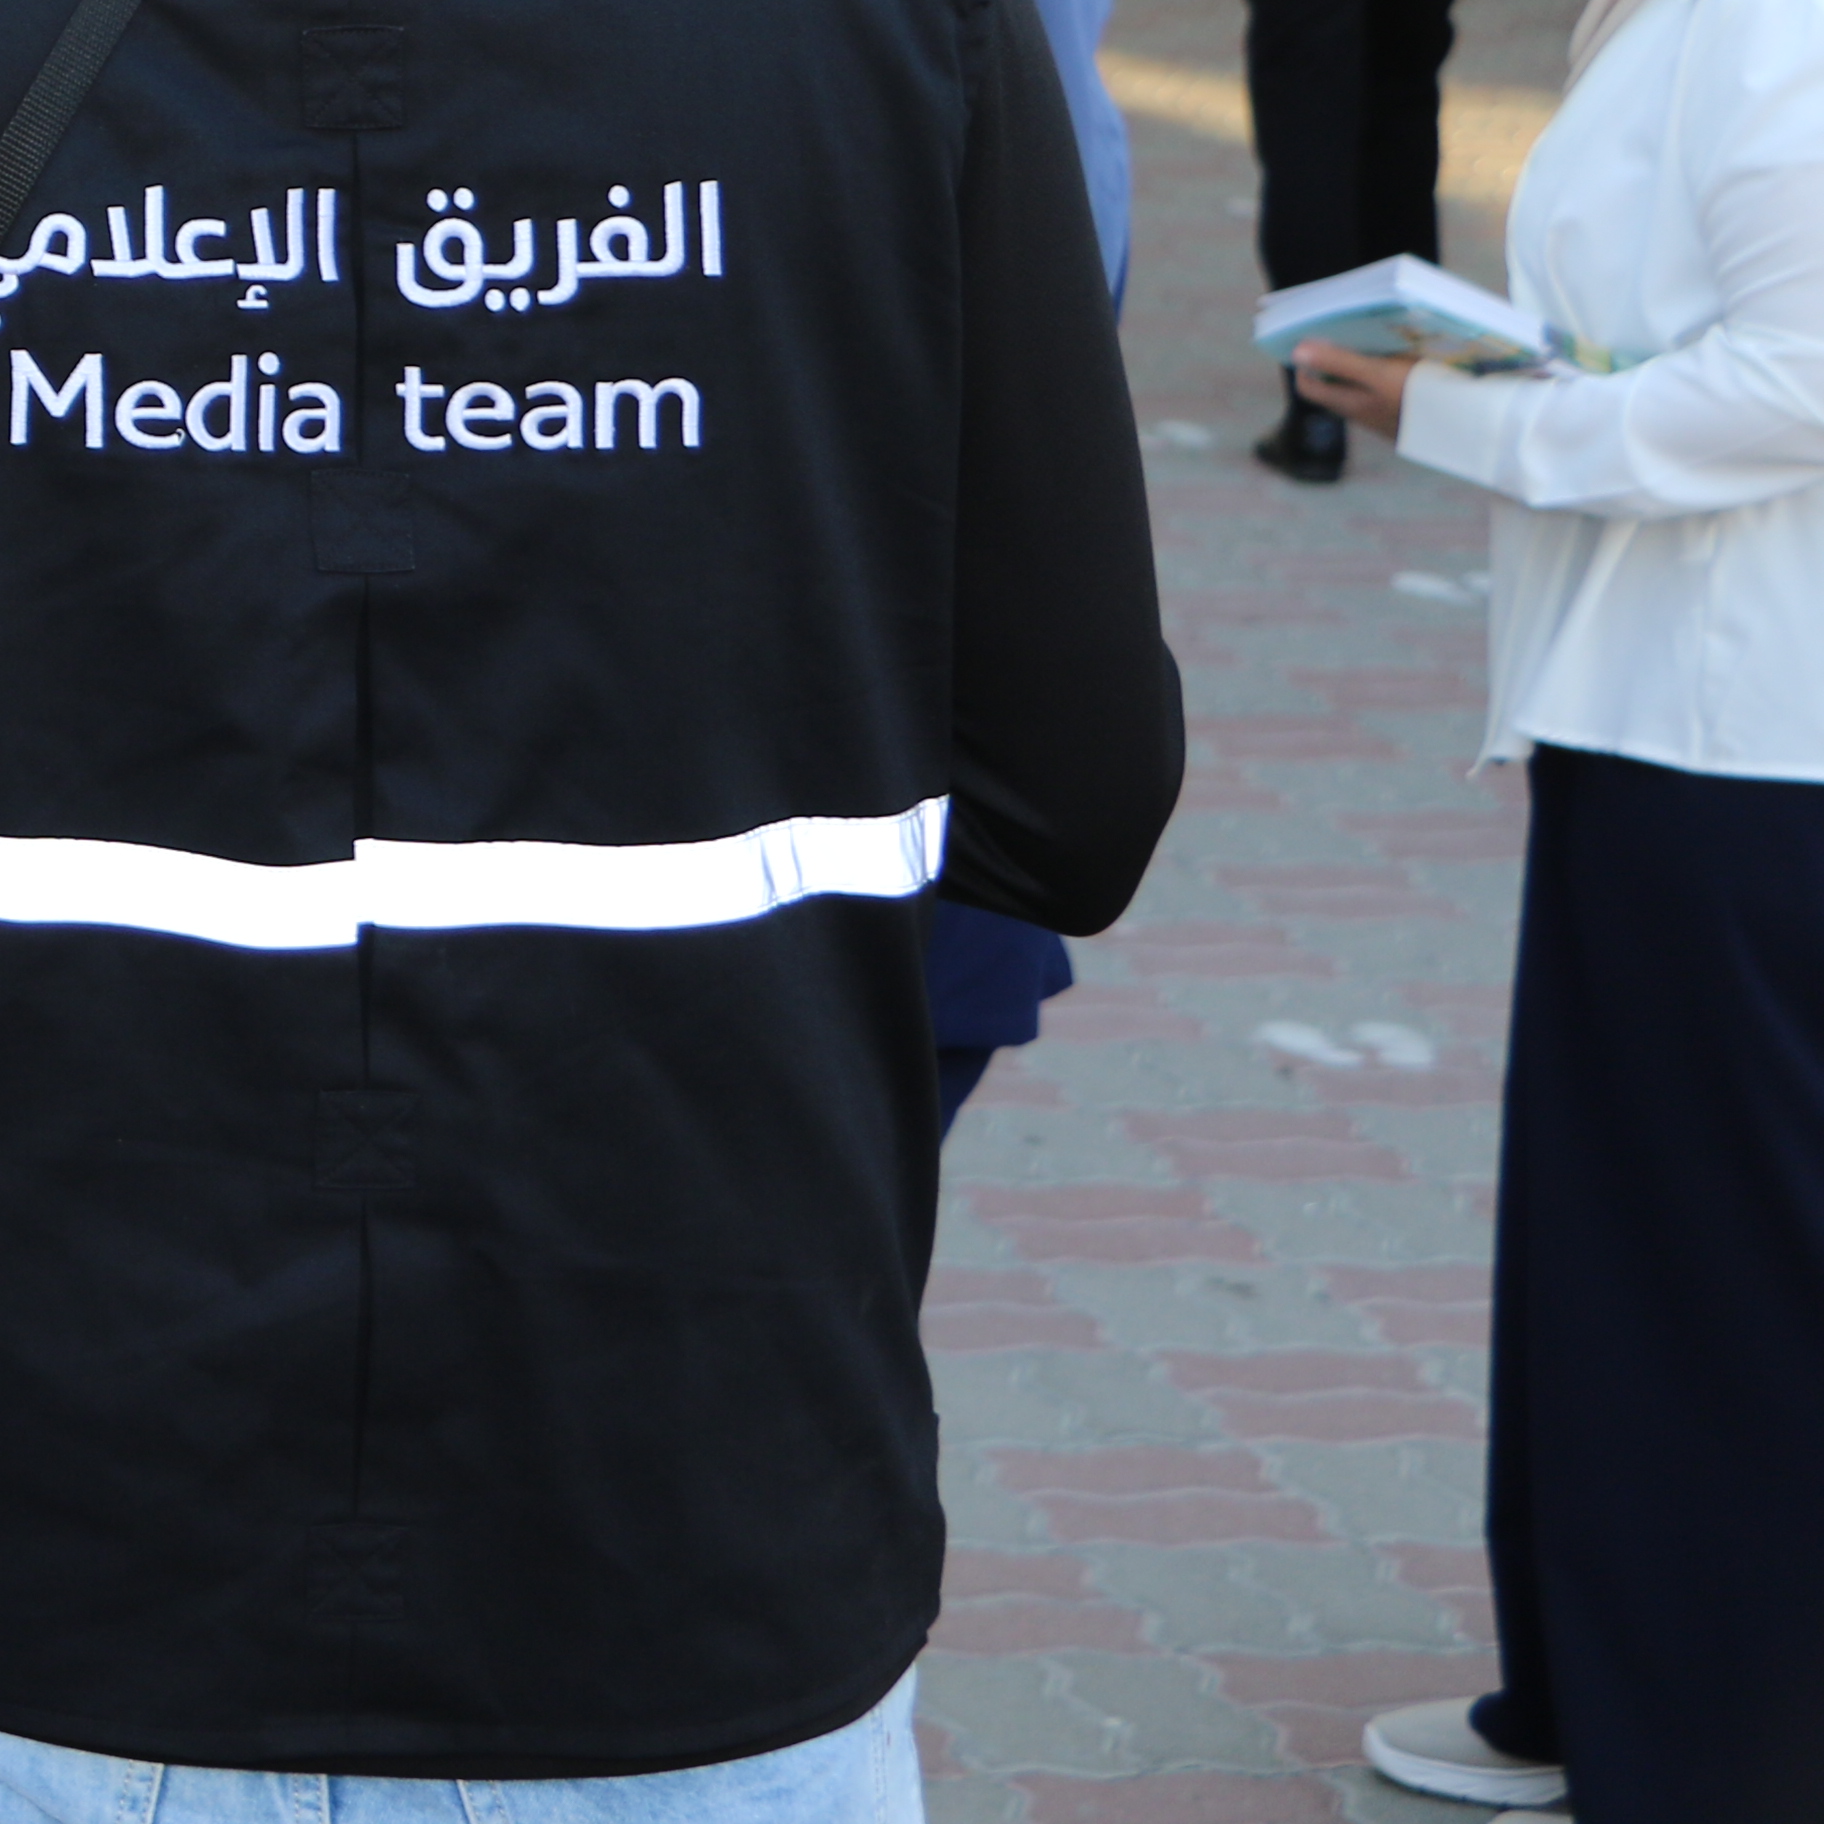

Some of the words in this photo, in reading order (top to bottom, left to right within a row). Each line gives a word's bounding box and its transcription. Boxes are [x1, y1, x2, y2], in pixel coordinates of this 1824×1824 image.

[396, 180, 723, 312] الفريق
[9, 349, 342, 454] Media
[395, 366, 701, 451] team
